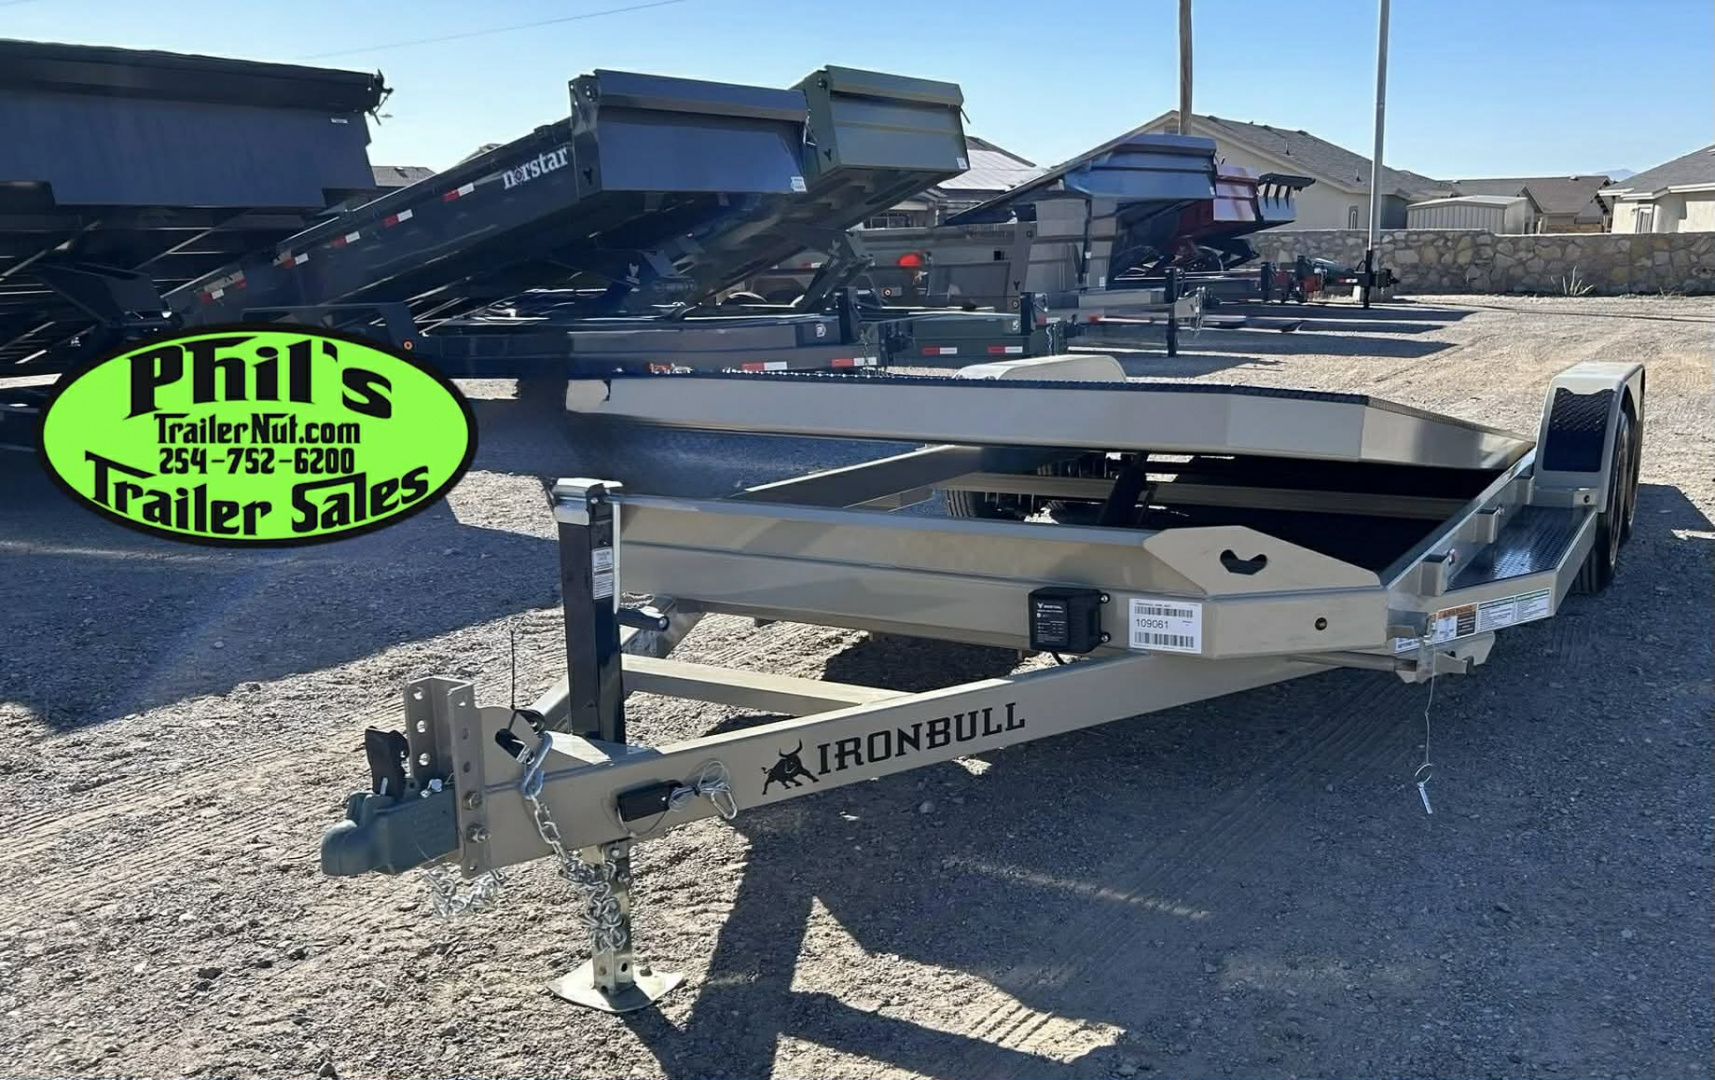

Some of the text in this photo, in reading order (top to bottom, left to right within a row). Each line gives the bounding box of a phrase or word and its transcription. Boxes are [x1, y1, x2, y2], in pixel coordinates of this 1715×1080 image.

[502, 147, 568, 189] norstar
[1136, 618, 1168, 629] 109061
[817, 702, 1025, 776] IRONBULL
